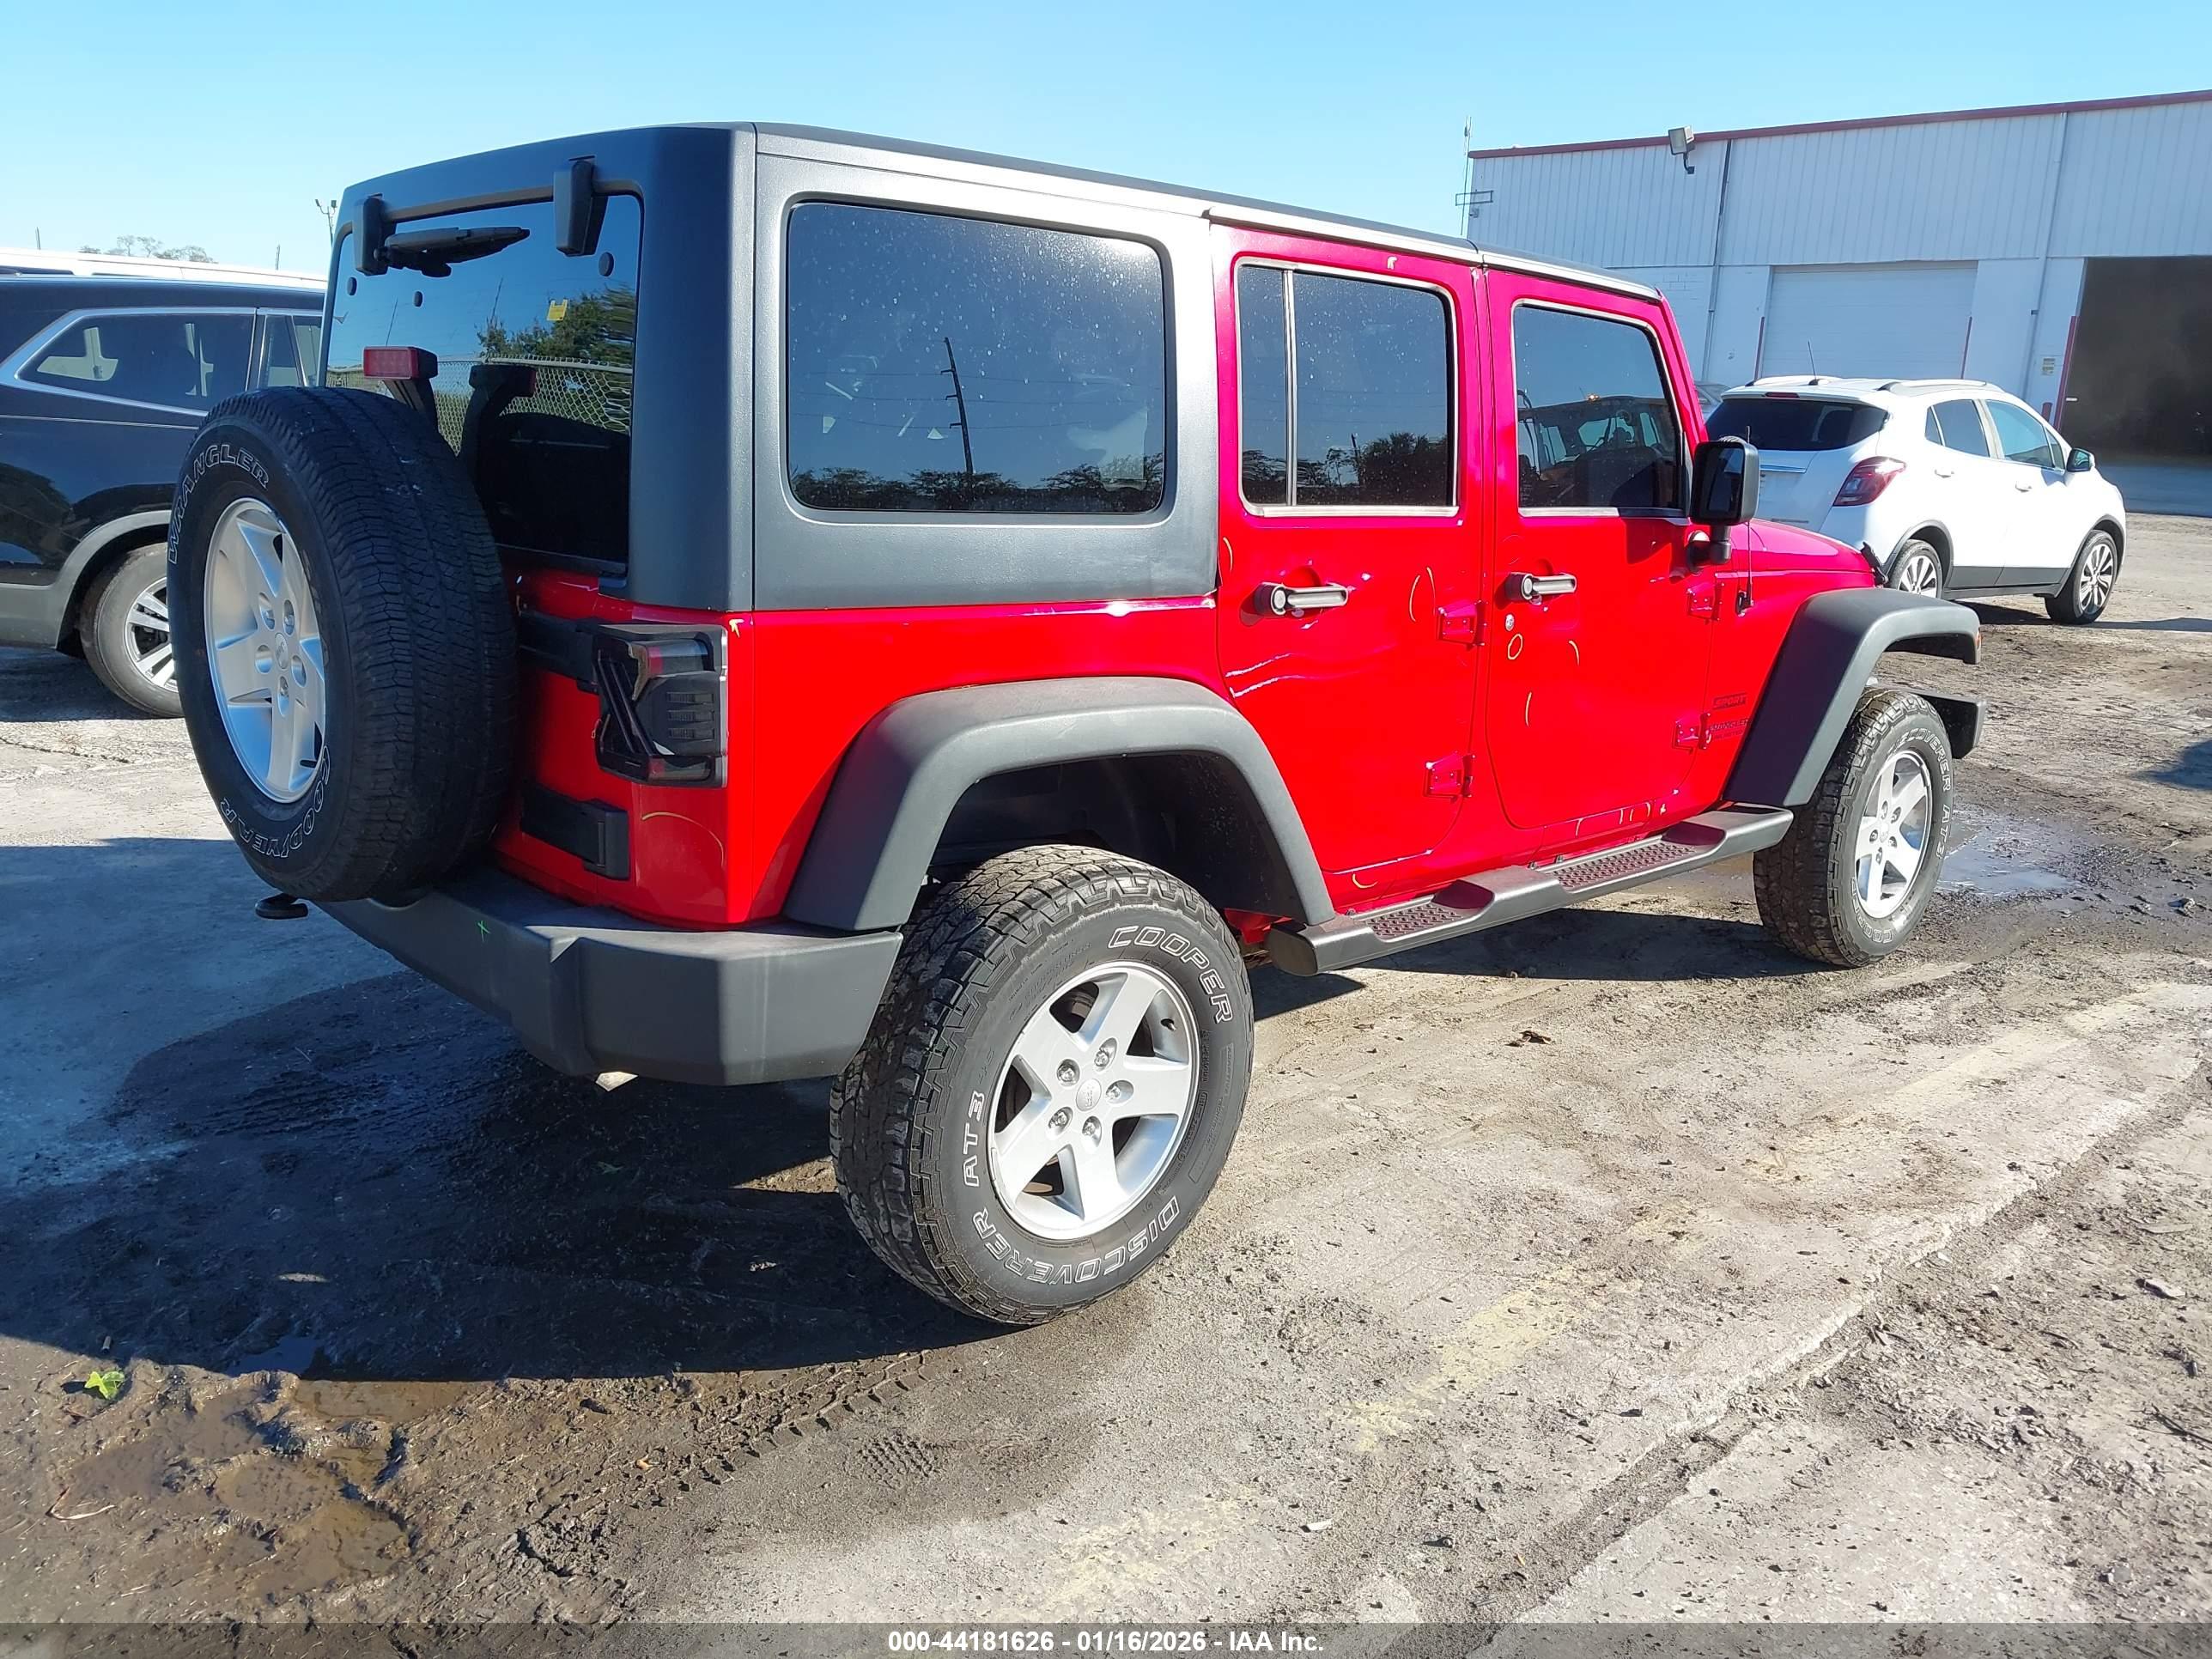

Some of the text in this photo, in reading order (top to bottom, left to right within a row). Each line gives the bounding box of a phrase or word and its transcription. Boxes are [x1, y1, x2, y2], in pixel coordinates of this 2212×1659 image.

[167, 444, 270, 565] WRANGLER
[220, 745, 331, 858] GOODYEAR
[1106, 924, 1234, 1024] COOPER
[962, 1091, 984, 1188] AT3
[972, 1194, 1180, 1286] DISCOVERER
